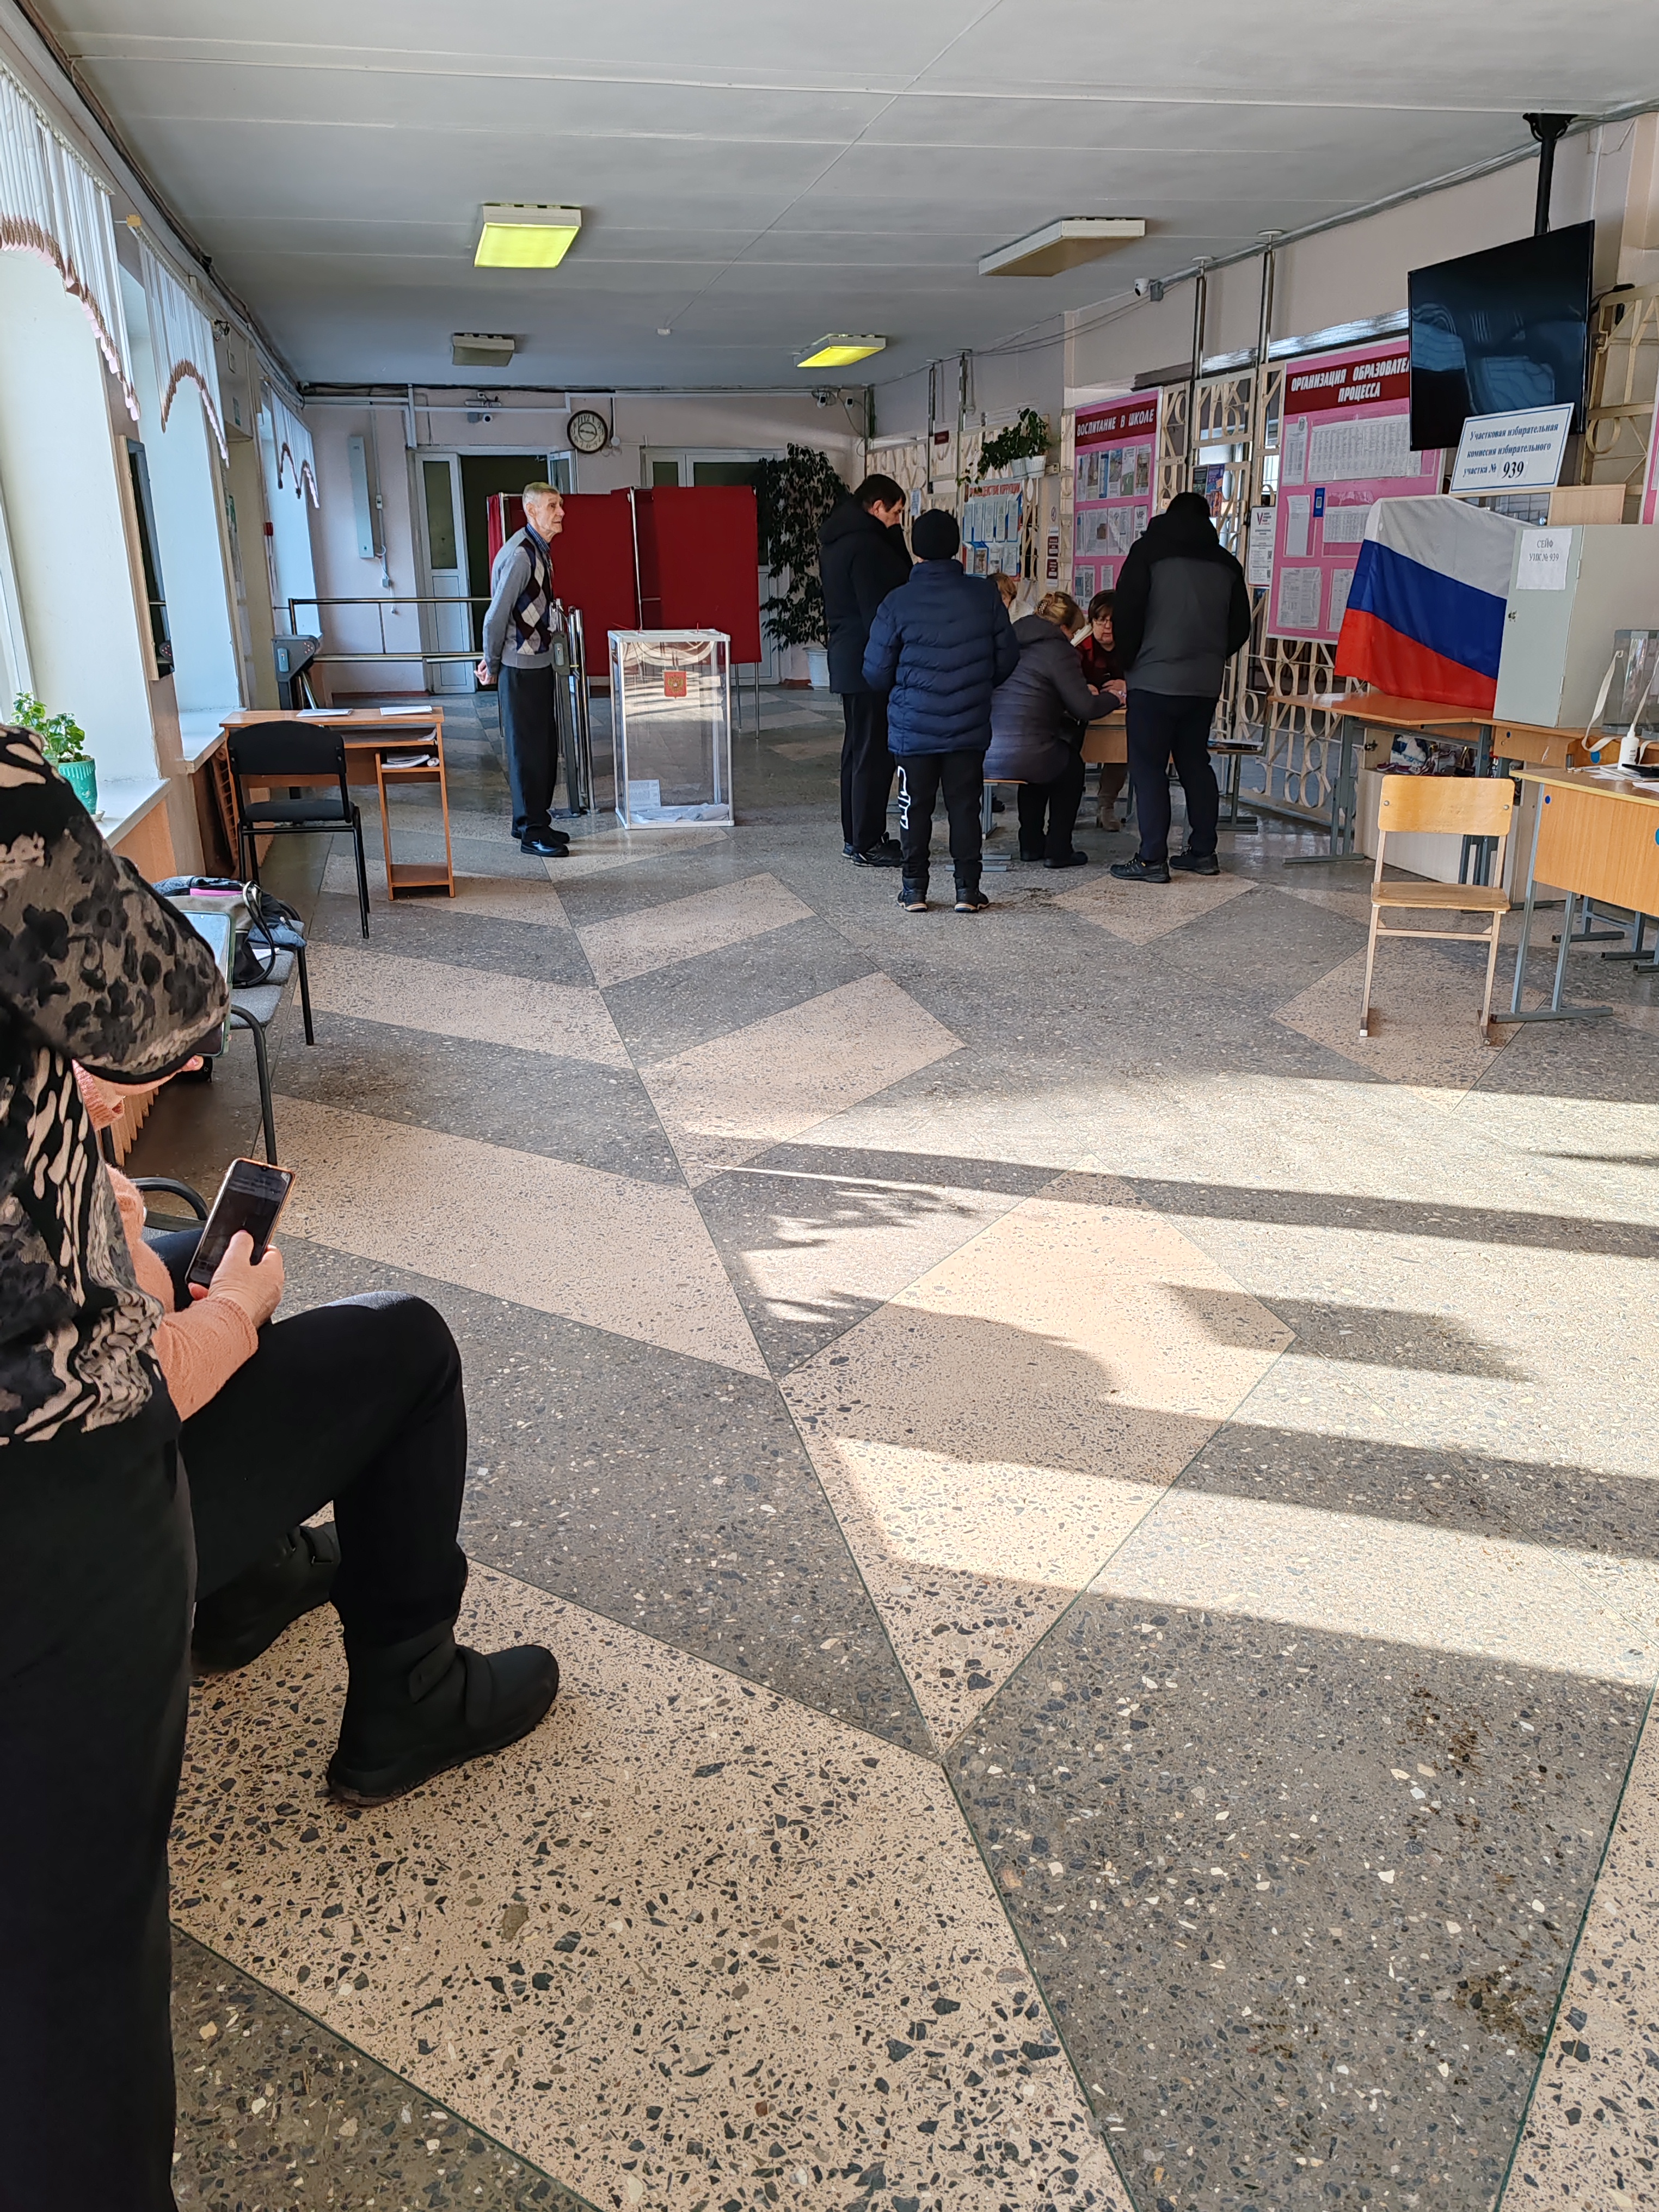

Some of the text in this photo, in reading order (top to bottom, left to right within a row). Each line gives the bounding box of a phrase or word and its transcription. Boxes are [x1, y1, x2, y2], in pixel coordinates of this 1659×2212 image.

[1291, 368, 1347, 392] ОРГАНИЗАЦИЯ
[1337, 382, 1381, 403] ПРОЦЕССА
[1077, 408, 1154, 437] ВОСПИТАНИЕ В ШКОЛЕ
[1470, 423, 1559, 441] Участковая избирательная
[1467, 443, 1551, 458] комиссия избирательного
[1463, 461, 1524, 478] участка № 939
[1537, 537, 1554, 548] СЕЙФ
[1529, 552, 1559, 562] УИК № 939
